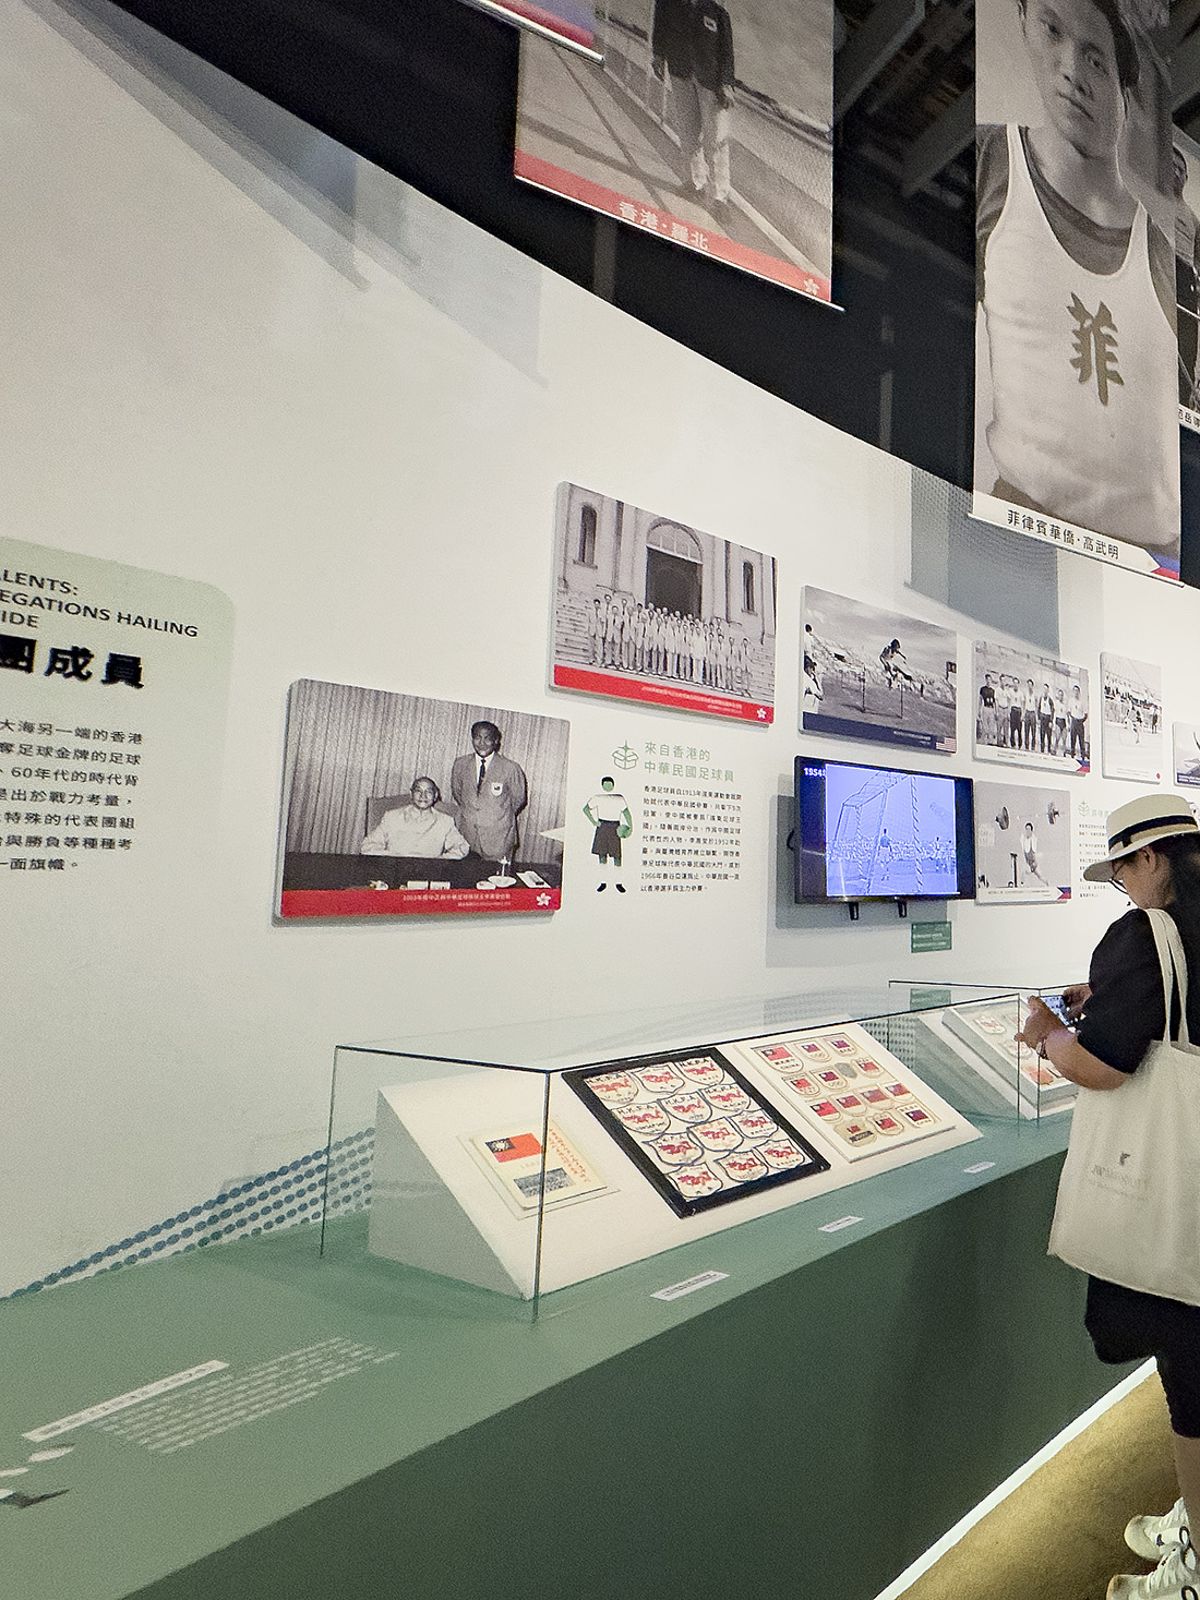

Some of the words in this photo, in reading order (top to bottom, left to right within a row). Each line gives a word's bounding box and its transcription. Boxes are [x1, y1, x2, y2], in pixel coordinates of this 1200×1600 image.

[1066, 291, 1125, 407] 菲
[1007, 509, 1119, 560] 菲律賓華僑·高武明
[0, 569, 78, 596] LENTS:
[0, 588, 110, 621] EGATIONS
[117, 611, 198, 637] HAILING
[2, 610, 39, 628] IDE
[0, 719, 143, 744] 大海另一端的香港
[644, 741, 711, 761] 來自香港的
[644, 761, 735, 782] 中華民國足球員
[0, 834, 132, 851] 與勝負等種種考
